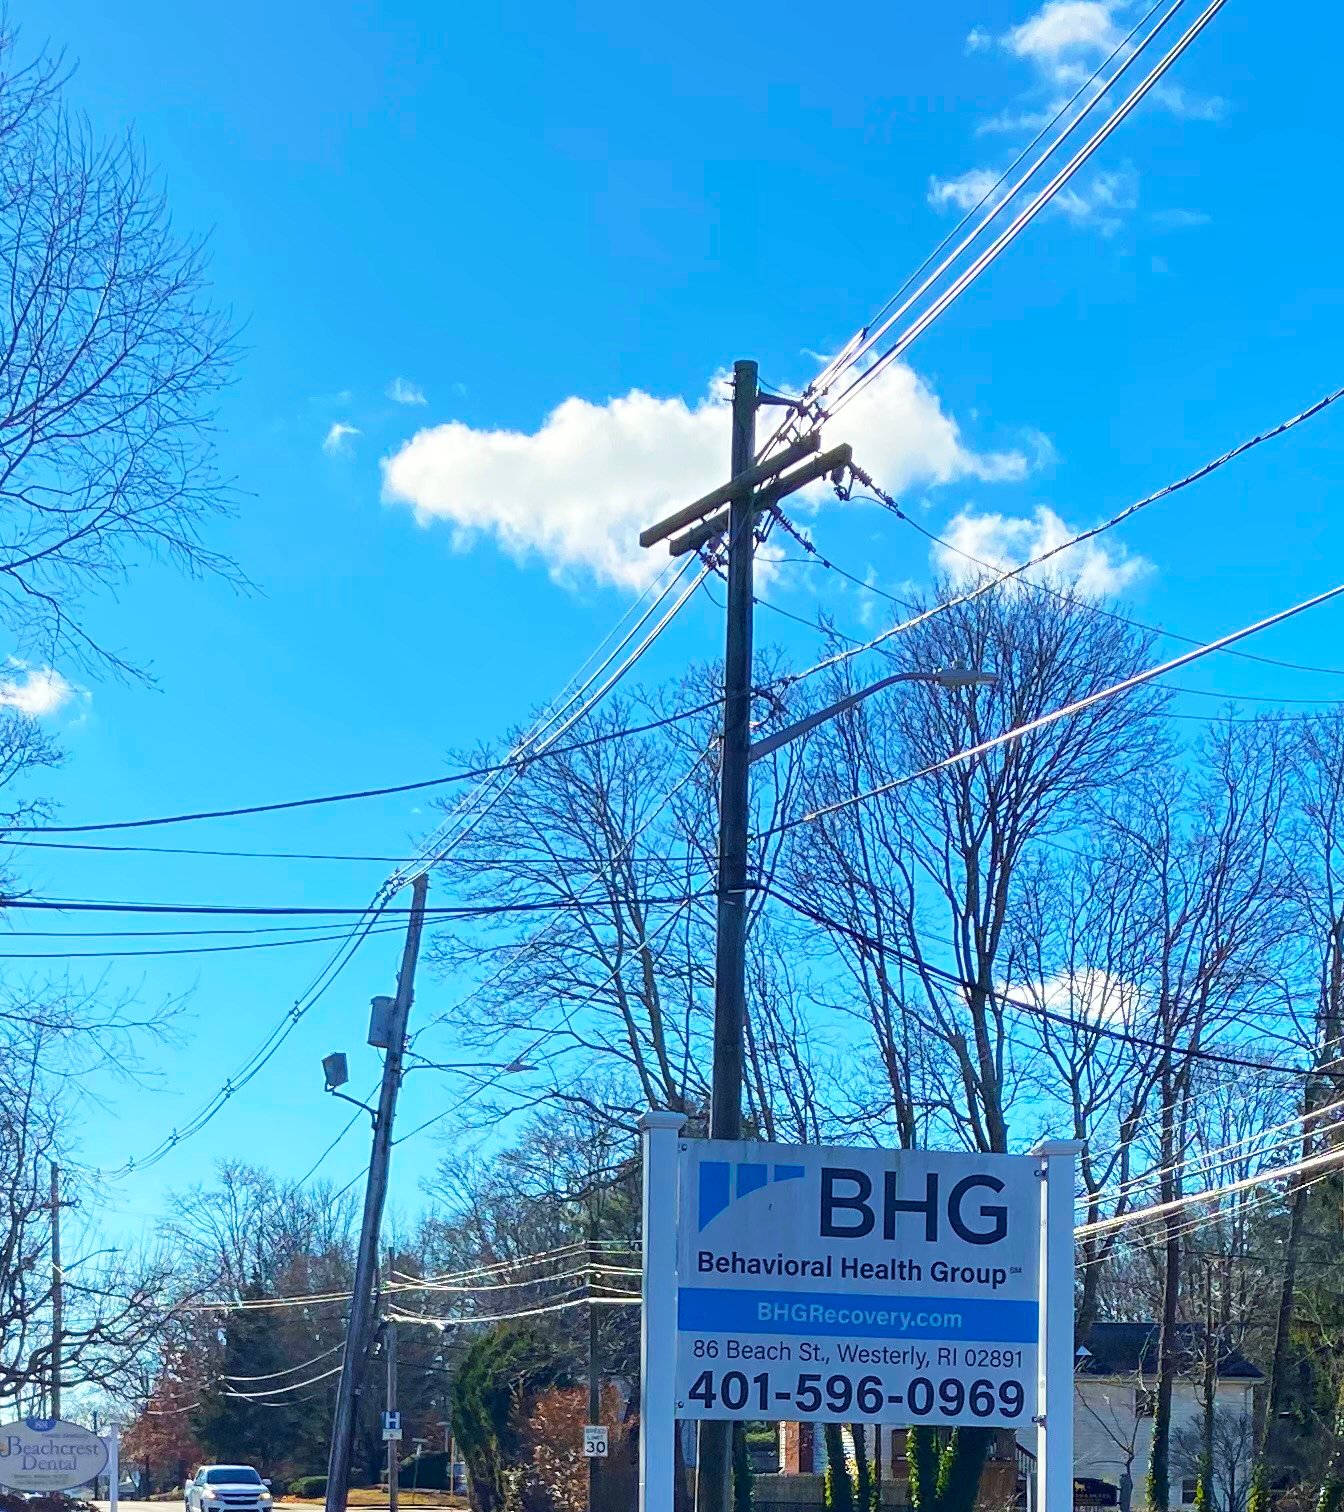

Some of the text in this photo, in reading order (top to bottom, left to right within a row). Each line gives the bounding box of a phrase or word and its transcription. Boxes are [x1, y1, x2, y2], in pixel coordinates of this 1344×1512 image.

[820, 1167, 1008, 1245] BHG
[698, 1251, 831, 1278] Behavioral
[841, 1257, 922, 1281] Health
[930, 1261, 1006, 1289] Group
[758, 1302, 962, 1331] BHGRecovery.com
[693, 1339, 1022, 1370] 86 Beach St., Westerly, RI 02891
[688, 1371, 1025, 1418] 401-596-0969
[385, 1411, 401, 1429] H
[5, 1436, 99, 1457] Beachcrest
[586, 1441, 606, 1453] 30
[22, 1455, 78, 1471] Dental
